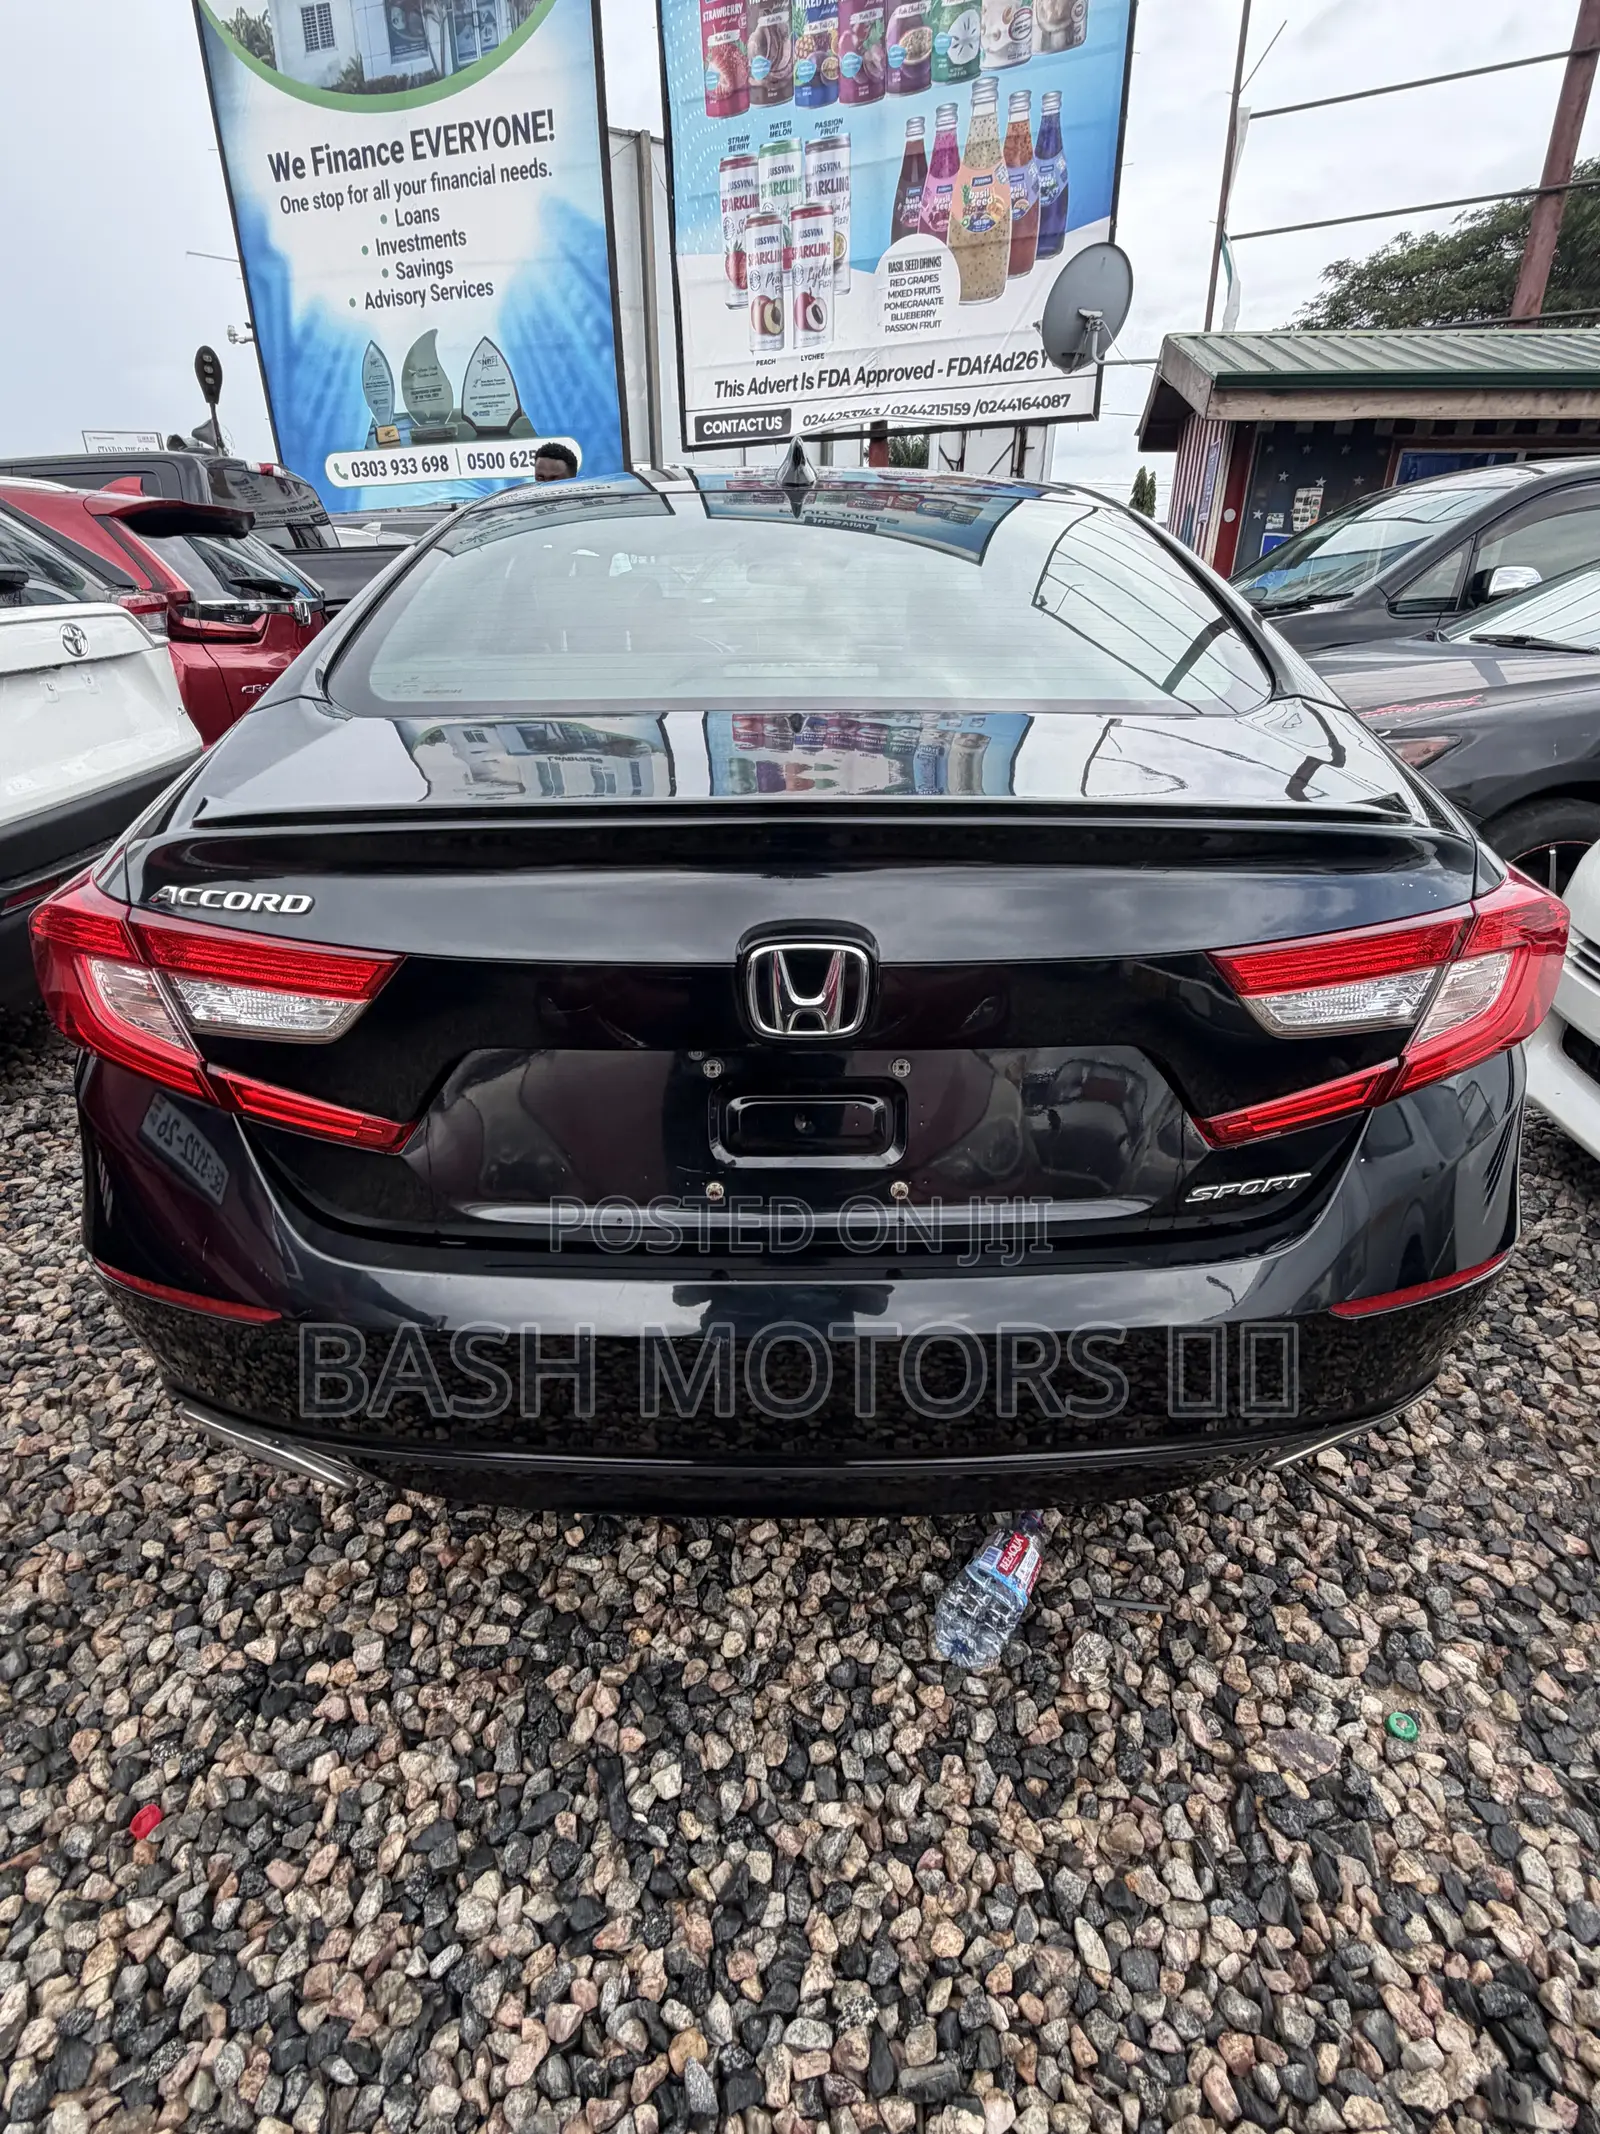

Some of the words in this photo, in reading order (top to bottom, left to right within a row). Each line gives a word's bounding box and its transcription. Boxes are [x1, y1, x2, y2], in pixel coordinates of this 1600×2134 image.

[702, 3, 744, 22] STRAWBERRY
[770, 120, 792, 131] WATER
[814, 118, 844, 130] PASSION
[820, 126, 840, 136] FRUIT
[728, 134, 750, 146] STRAW
[769, 128, 792, 138] MELON
[268, 150, 306, 182] We
[310, 140, 404, 177] Finance
[410, 109, 556, 162] EVERYONE!
[728, 142, 750, 152] BERRY
[280, 196, 309, 214] One
[312, 190, 344, 212] stop
[348, 185, 368, 205] for
[373, 180, 390, 200] all
[394, 181, 426, 203] your
[431, 165, 496, 194] financial
[500, 158, 553, 183] needs.
[805, 176, 849, 198] SPARKLING
[968, 188, 990, 198] basil
[722, 193, 759, 213] SPARKLIN
[395, 206, 440, 227] Loans
[376, 229, 467, 257] Investments
[748, 250, 782, 267] SPARKLIN
[888, 260, 904, 274] BASIL
[905, 258, 919, 271] SEED
[920, 256, 942, 269] DRINKS
[395, 258, 454, 282] Savings
[890, 278, 906, 288] RED
[908, 274, 940, 285] GRAPES
[364, 289, 426, 310] Advisory
[430, 280, 494, 302] Services
[888, 289, 912, 300] MIXED
[914, 285, 941, 296] FRUITS
[884, 296, 944, 311] POMEGRANATE
[891, 309, 936, 321] BLUEBERRY
[885, 322, 918, 333] PASSION
[920, 320, 942, 330] FRUIT
[800, 353, 824, 362] LYCHEE
[714, 380, 744, 398] This
[747, 374, 798, 396] Advert
[801, 372, 814, 390] Is
[818, 368, 850, 388] FDA
[854, 360, 935, 388] Approved
[891, 402, 970, 416] 0244215159
[703, 418, 764, 435] CONTACT
[766, 416, 782, 430] US
[351, 460, 388, 478] 0303
[390, 458, 418, 474] 933
[422, 454, 449, 473] 698
[468, 452, 506, 470] 0500
[509, 450, 536, 468] 625
[149, 885, 316, 914] ACCORD
[1184, 1172, 1312, 1202] SPORT
